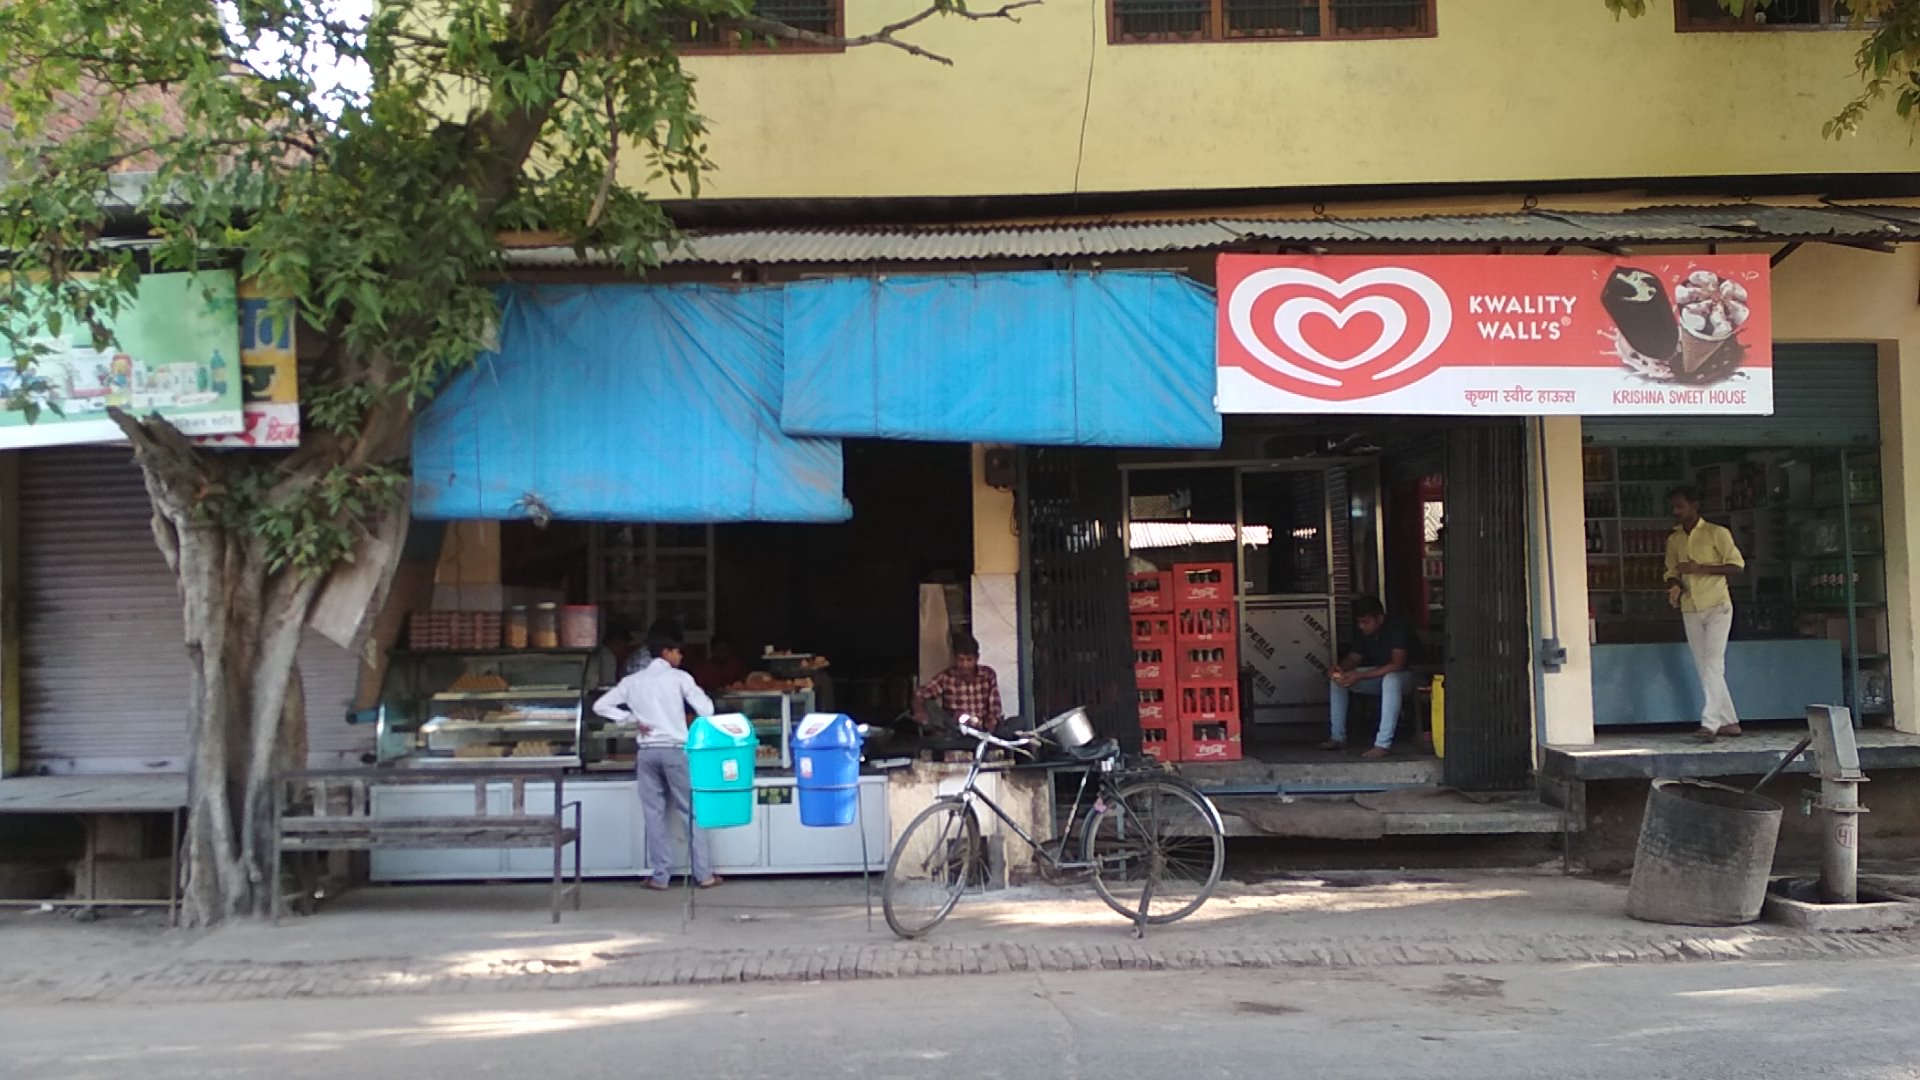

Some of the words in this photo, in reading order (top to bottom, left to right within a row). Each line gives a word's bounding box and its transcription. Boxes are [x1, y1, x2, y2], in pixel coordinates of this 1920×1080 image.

[1469, 295, 1577, 314] KWALITY
[1477, 321, 1561, 340] WALL'S
[1464, 390, 1498, 407] कृष्णा
[1502, 385, 1533, 403] स्वीट
[1537, 390, 1576, 403] हाऊस
[1612, 390, 1665, 405] KRISHNA
[1669, 390, 1705, 405] SWEET
[1709, 390, 1747, 405] HOUSE
